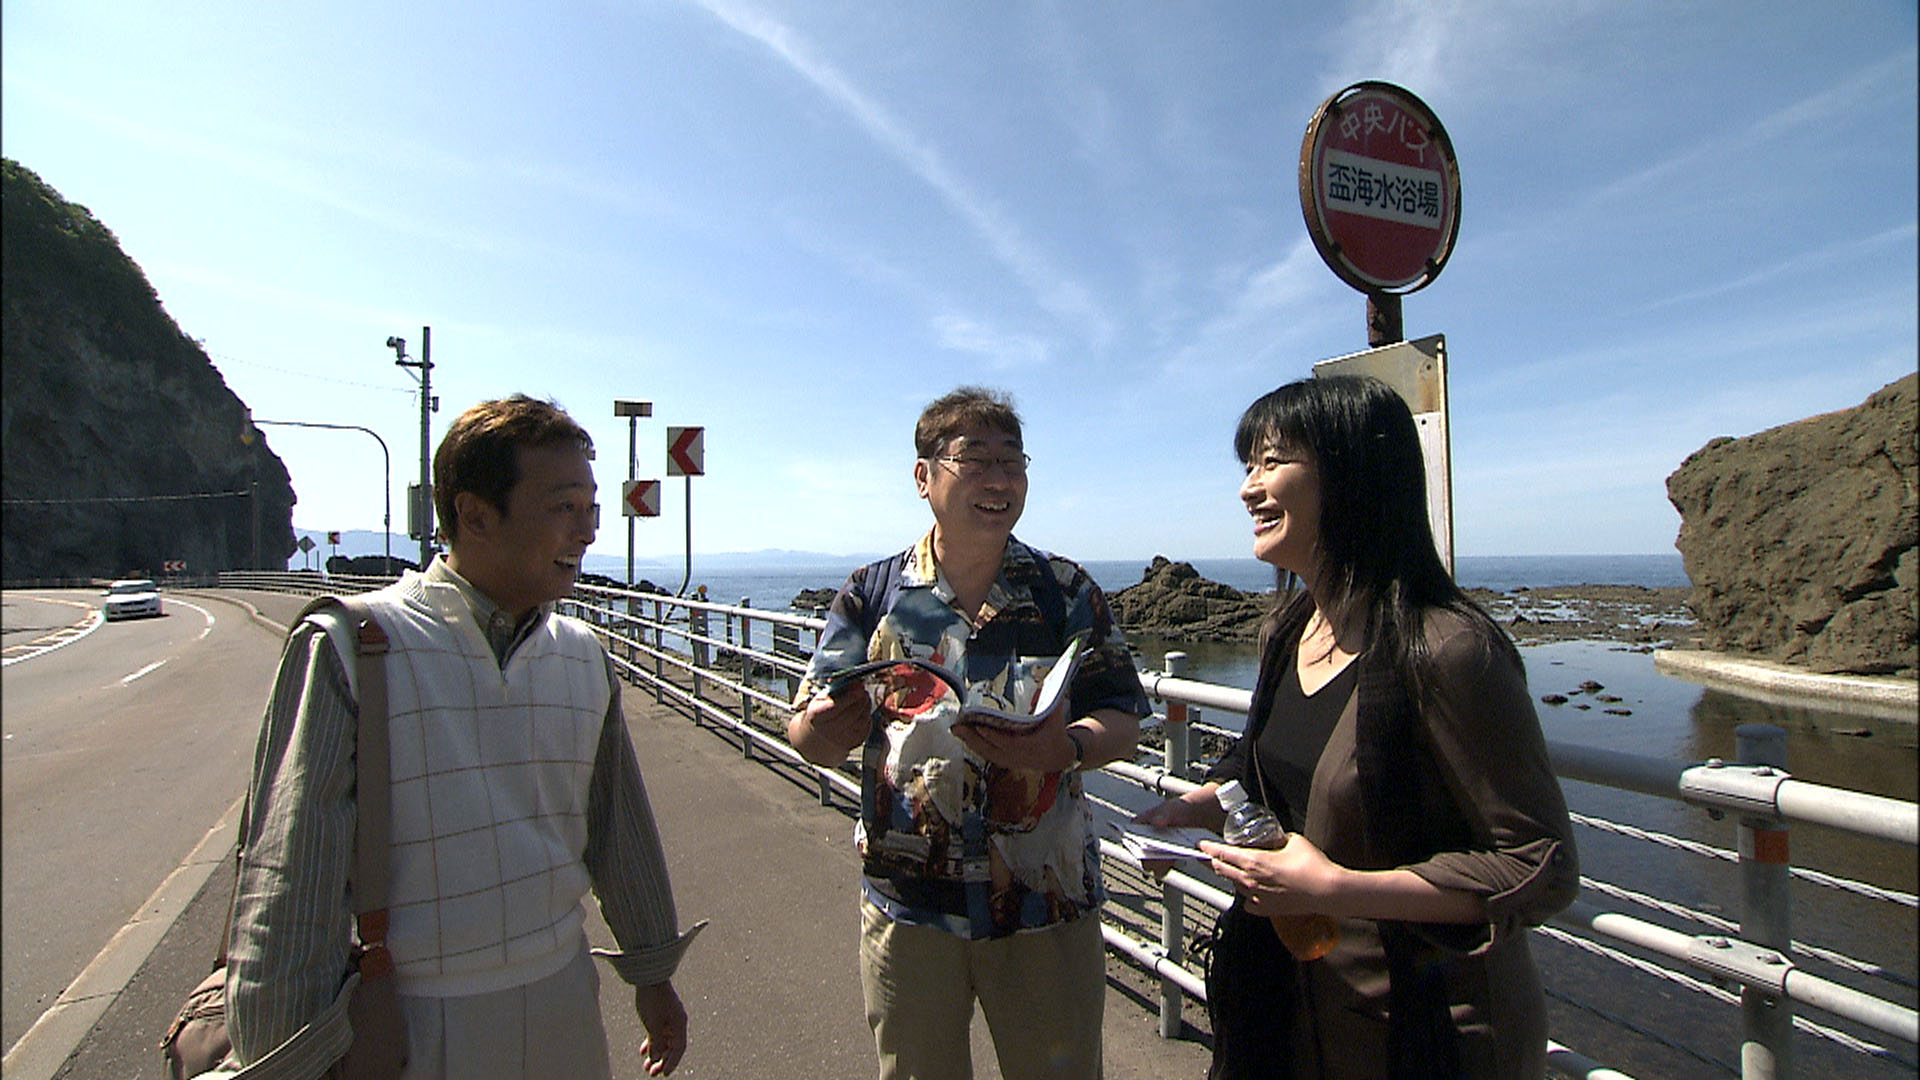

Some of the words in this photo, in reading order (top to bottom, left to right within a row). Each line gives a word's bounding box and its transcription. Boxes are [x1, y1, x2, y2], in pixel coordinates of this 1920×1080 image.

[1341, 103, 1430, 163] 中央バス
[1328, 163, 1439, 218] 盃海水浴場
